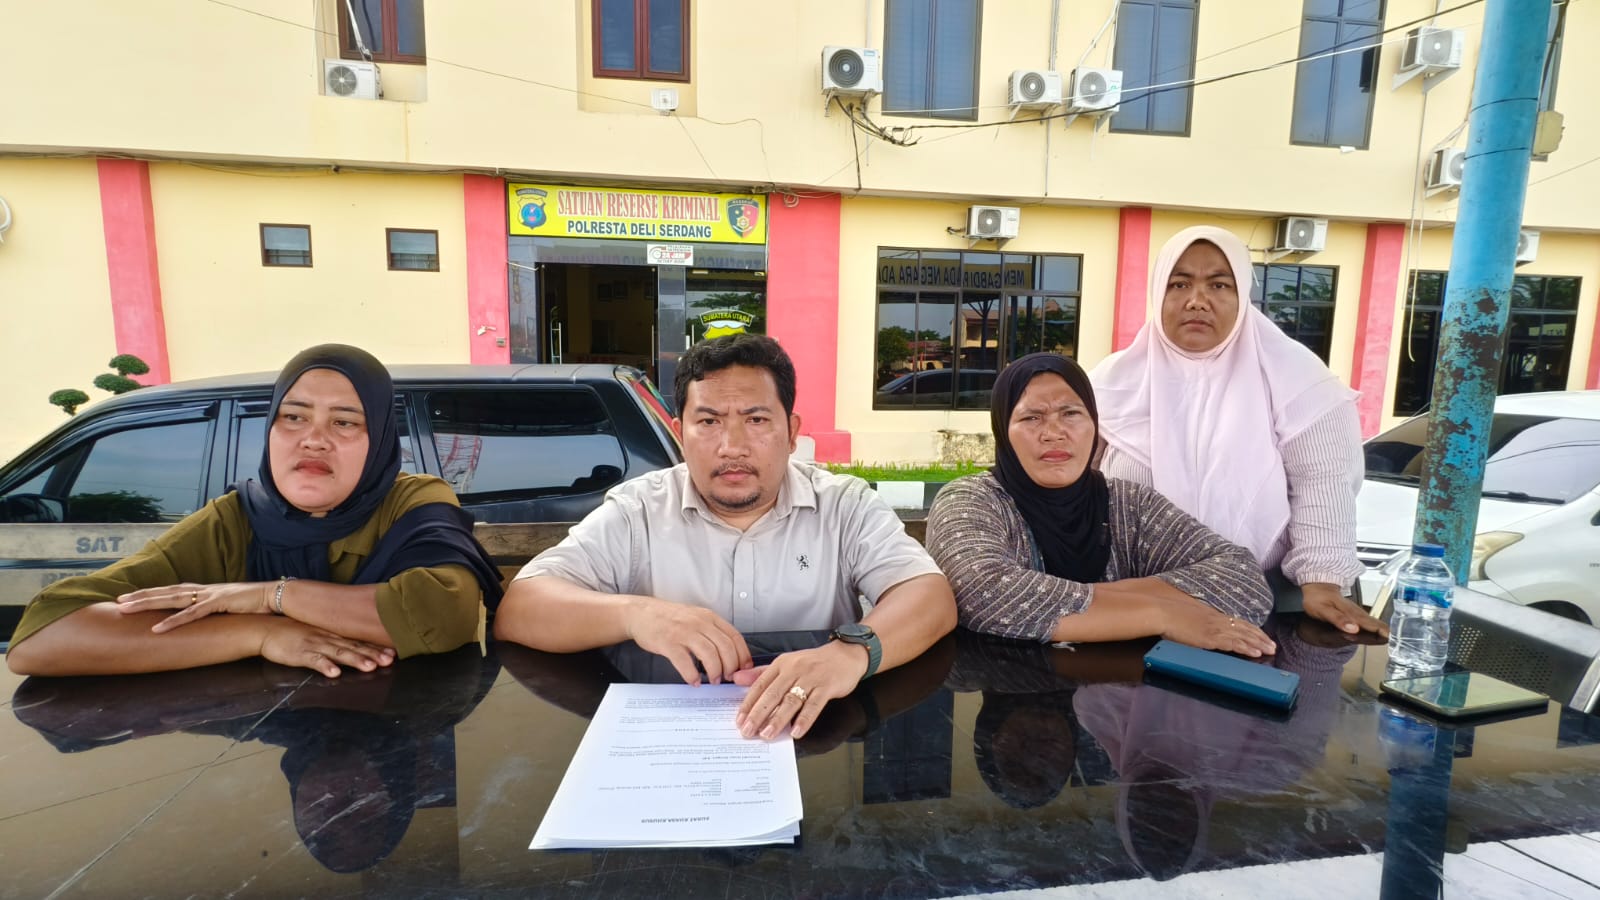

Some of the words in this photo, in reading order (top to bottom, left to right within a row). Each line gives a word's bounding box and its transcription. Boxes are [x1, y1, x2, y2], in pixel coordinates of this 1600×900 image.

[558, 190, 604, 216] SATUAN
[606, 192, 658, 219] RESERSE
[662, 195, 721, 221] KRIMINAL
[567, 220, 627, 235] POLRESTA
[630, 222, 656, 236] DELI
[659, 224, 712, 238] SERDANG
[76, 536, 124, 553] SAT
